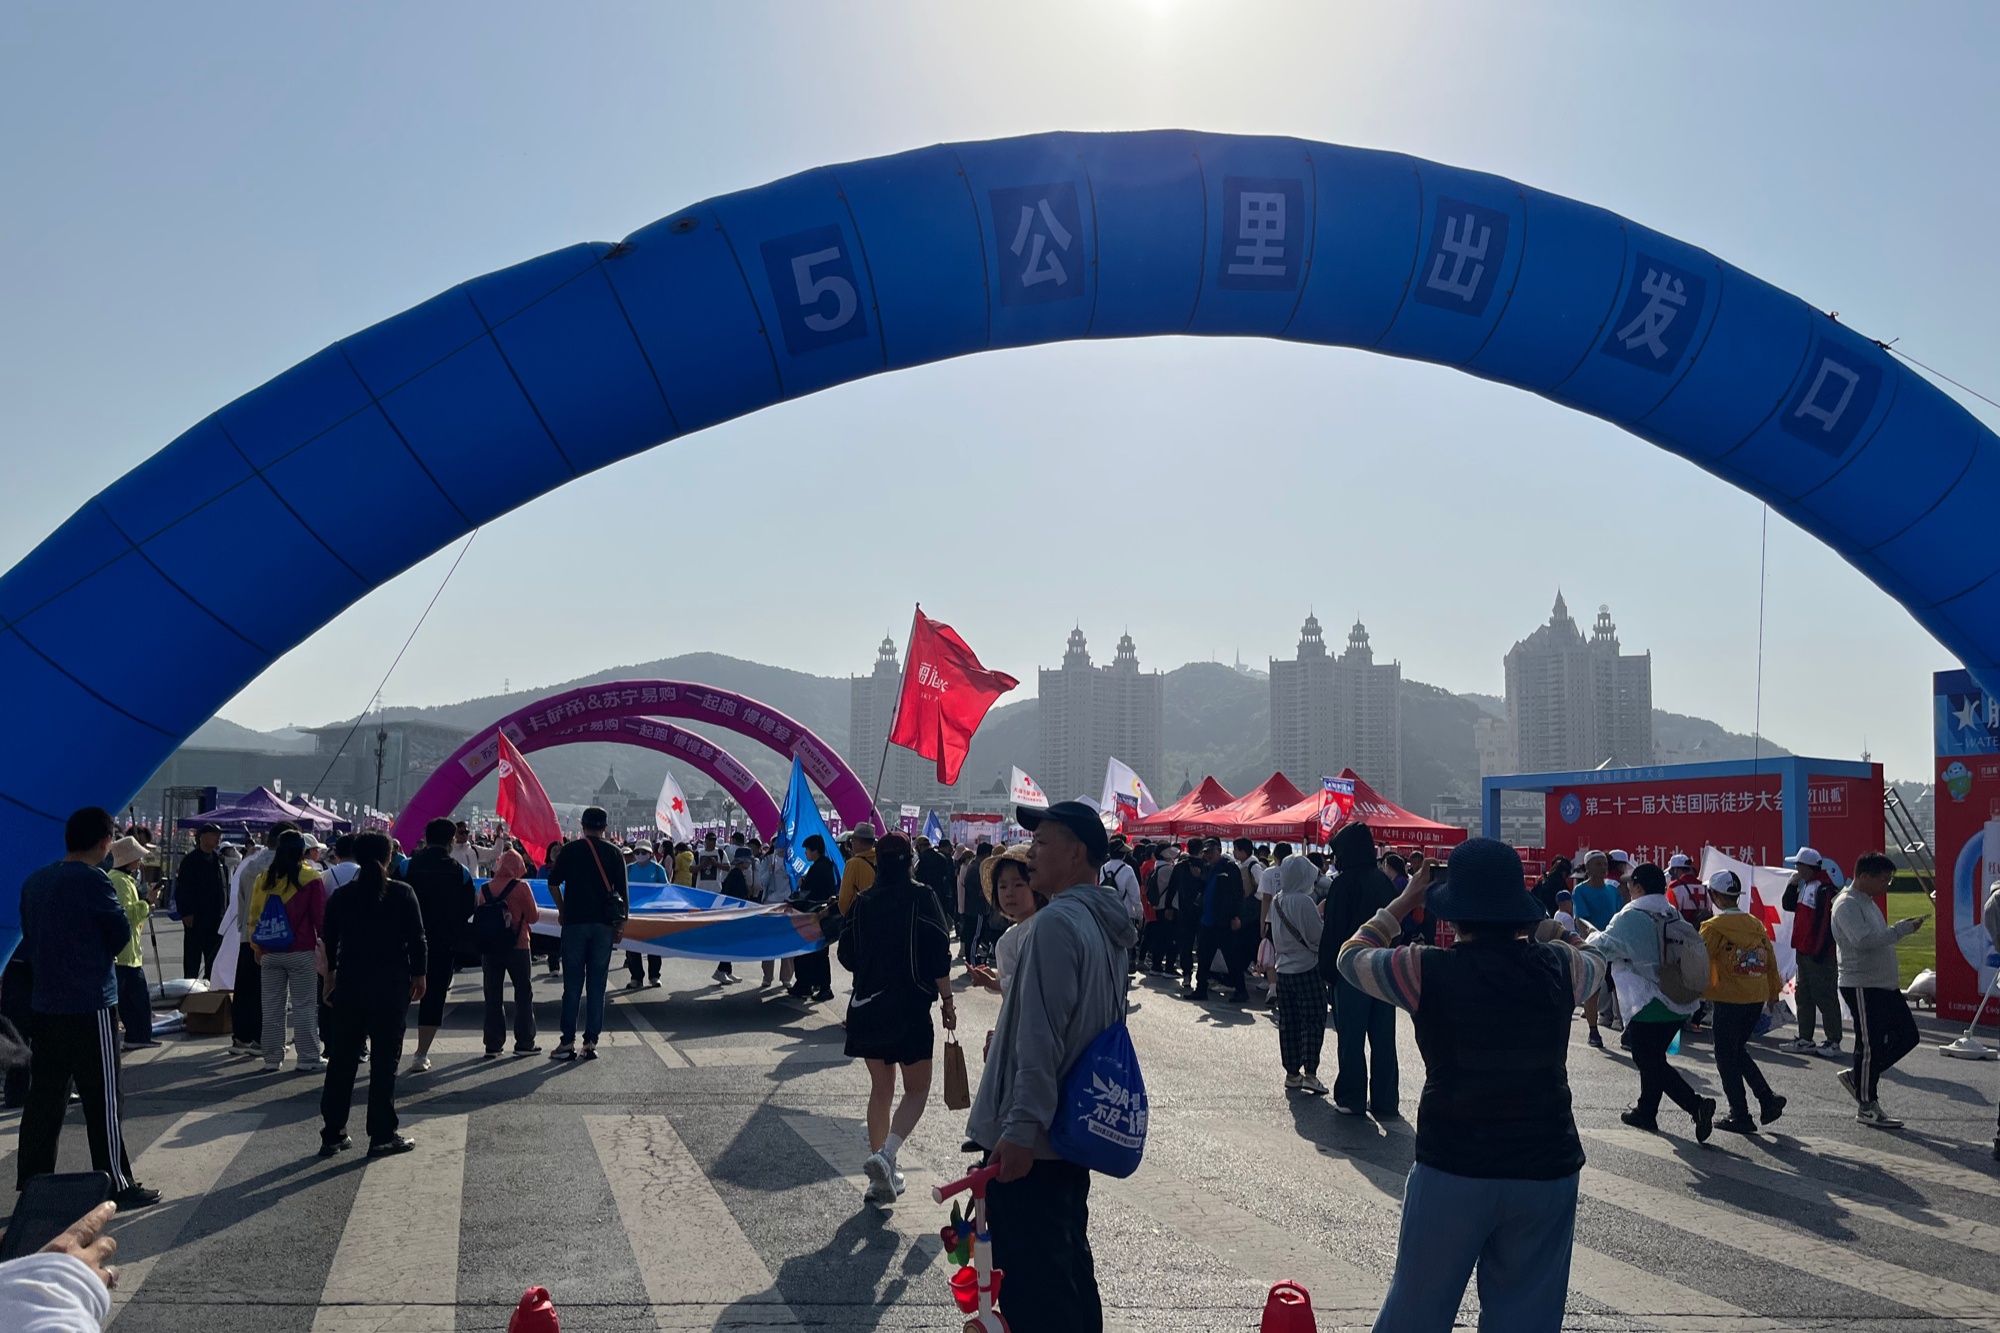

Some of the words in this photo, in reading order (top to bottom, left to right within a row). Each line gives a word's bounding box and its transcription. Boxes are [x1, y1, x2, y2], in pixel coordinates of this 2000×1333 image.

[791, 191, 1859, 432] 5公里出发口
[527, 686, 677, 732] 卡萨帝&苏宁易购
[686, 691, 737, 717] 一起跑
[741, 707, 792, 743] 慢慢爱
[480, 729, 519, 760] 苏宁购
[625, 723, 669, 741] 一起跑
[673, 732, 717, 761] 慢慢爱
[800, 740, 832, 776] Casarte
[1585, 790, 1783, 816] 第二十二届大连国际徒步大会
